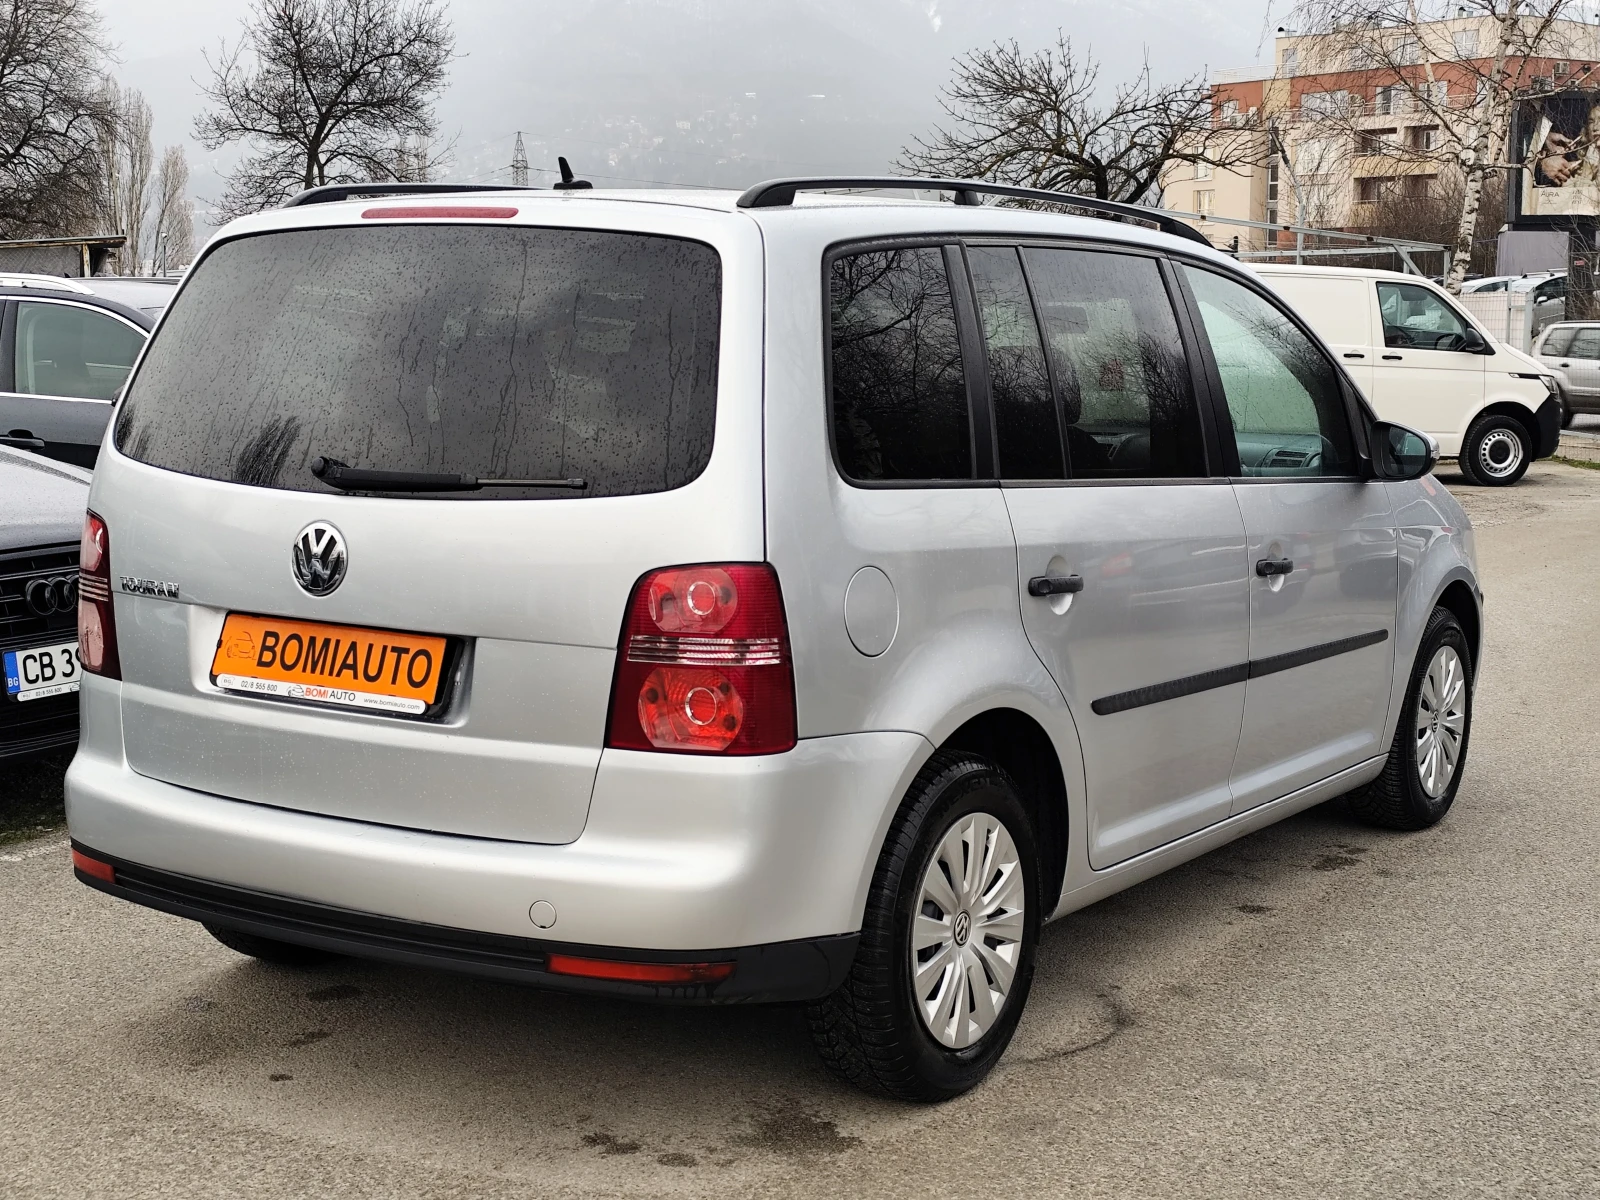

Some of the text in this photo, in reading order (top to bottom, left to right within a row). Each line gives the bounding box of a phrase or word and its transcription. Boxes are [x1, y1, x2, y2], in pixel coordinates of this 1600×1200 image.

[120, 576, 179, 599] TOURAN
[22, 651, 56, 685] CB
[256, 630, 432, 689] BOMIAUTO
[7, 677, 19, 688] BG
[304, 687, 356, 702] BOMI AUTO
[363, 697, 420, 711] www.bomiauto.com
